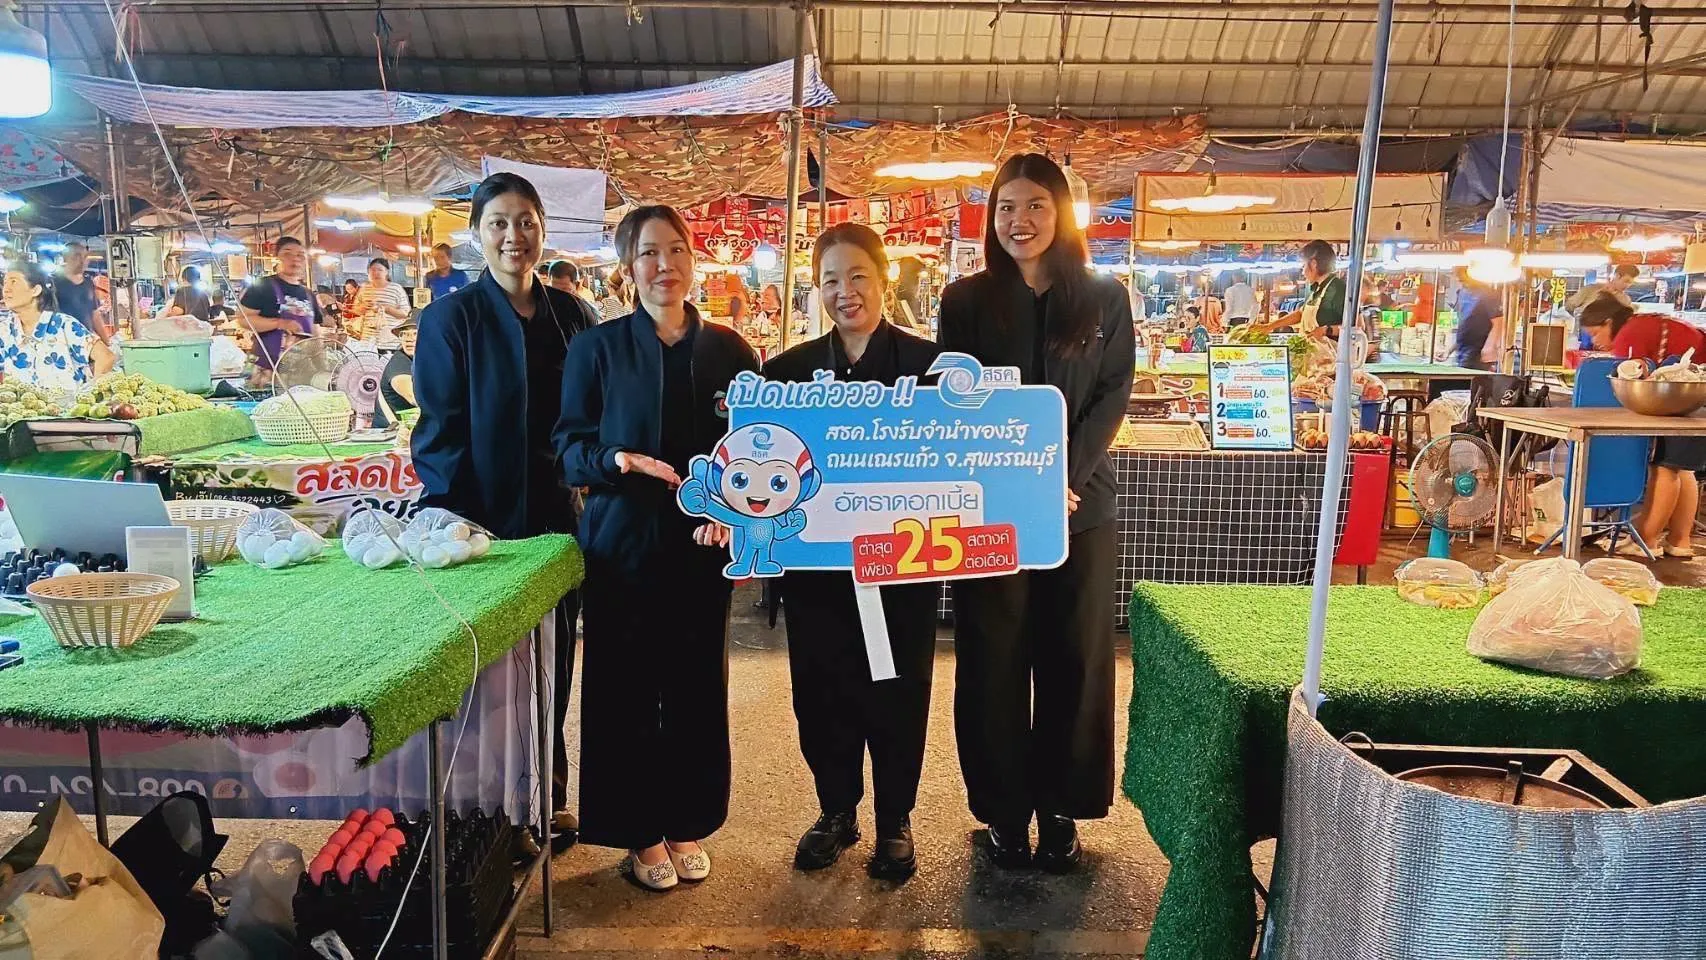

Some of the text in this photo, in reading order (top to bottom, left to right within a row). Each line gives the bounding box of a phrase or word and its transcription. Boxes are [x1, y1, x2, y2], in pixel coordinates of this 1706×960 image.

[983, 368, 1017, 382] สธค.
[727, 369, 918, 408] เปิดแล้ววว !!
[1216, 402, 1226, 418] 2
[825, 418, 1029, 446] สธค.โรงรับจำนำของรัฐ
[1217, 422, 1227, 436] 3
[826, 444, 1058, 475] ถนนเณรแก้ว จ.สุพรรณบุรี
[834, 485, 978, 512] อัตราดอกเบี้ย
[858, 538, 893, 558] ต่ำสุด
[893, 515, 964, 575] 25
[967, 530, 1010, 547] สตางค์
[861, 562, 894, 577] เพียง
[964, 551, 1015, 569] ต่อเดือน
